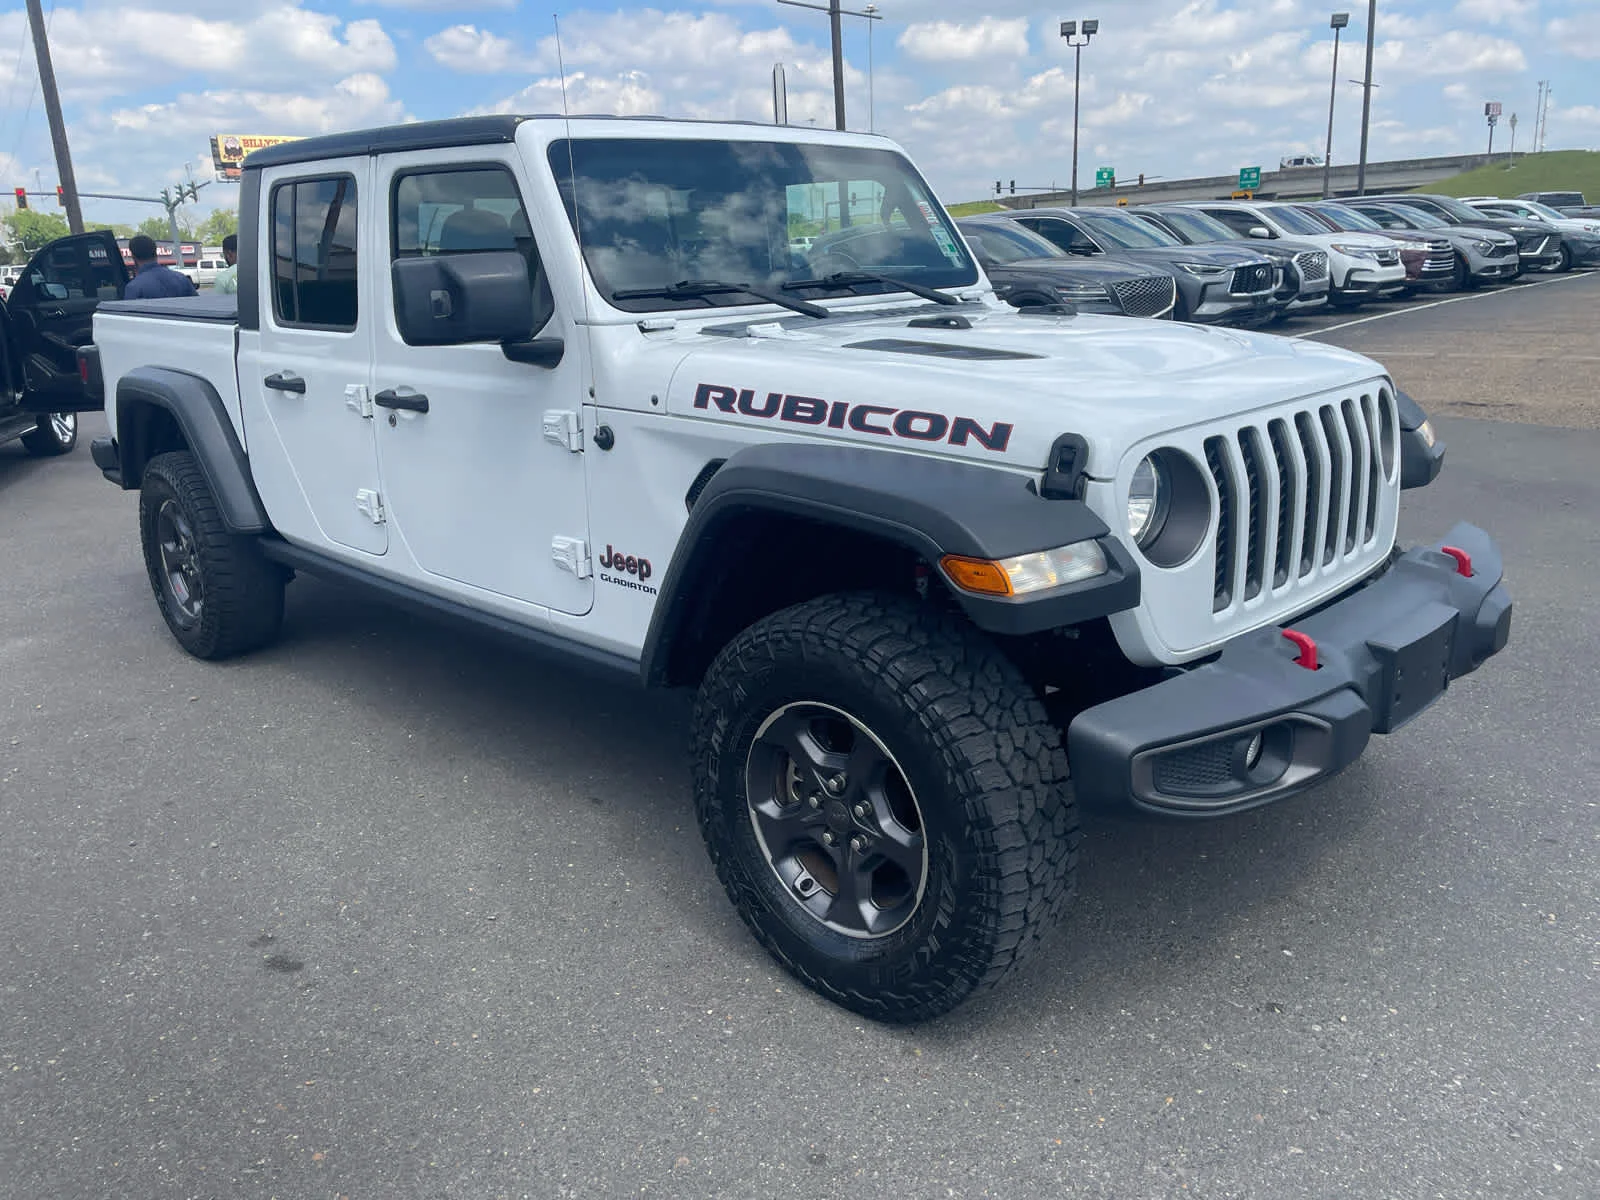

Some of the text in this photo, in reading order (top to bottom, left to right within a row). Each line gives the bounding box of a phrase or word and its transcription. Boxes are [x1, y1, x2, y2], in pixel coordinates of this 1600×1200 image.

[693, 383, 1014, 452] RUBICON
[600, 544, 651, 582] Jeep
[600, 573, 657, 595] GLADIATOR
